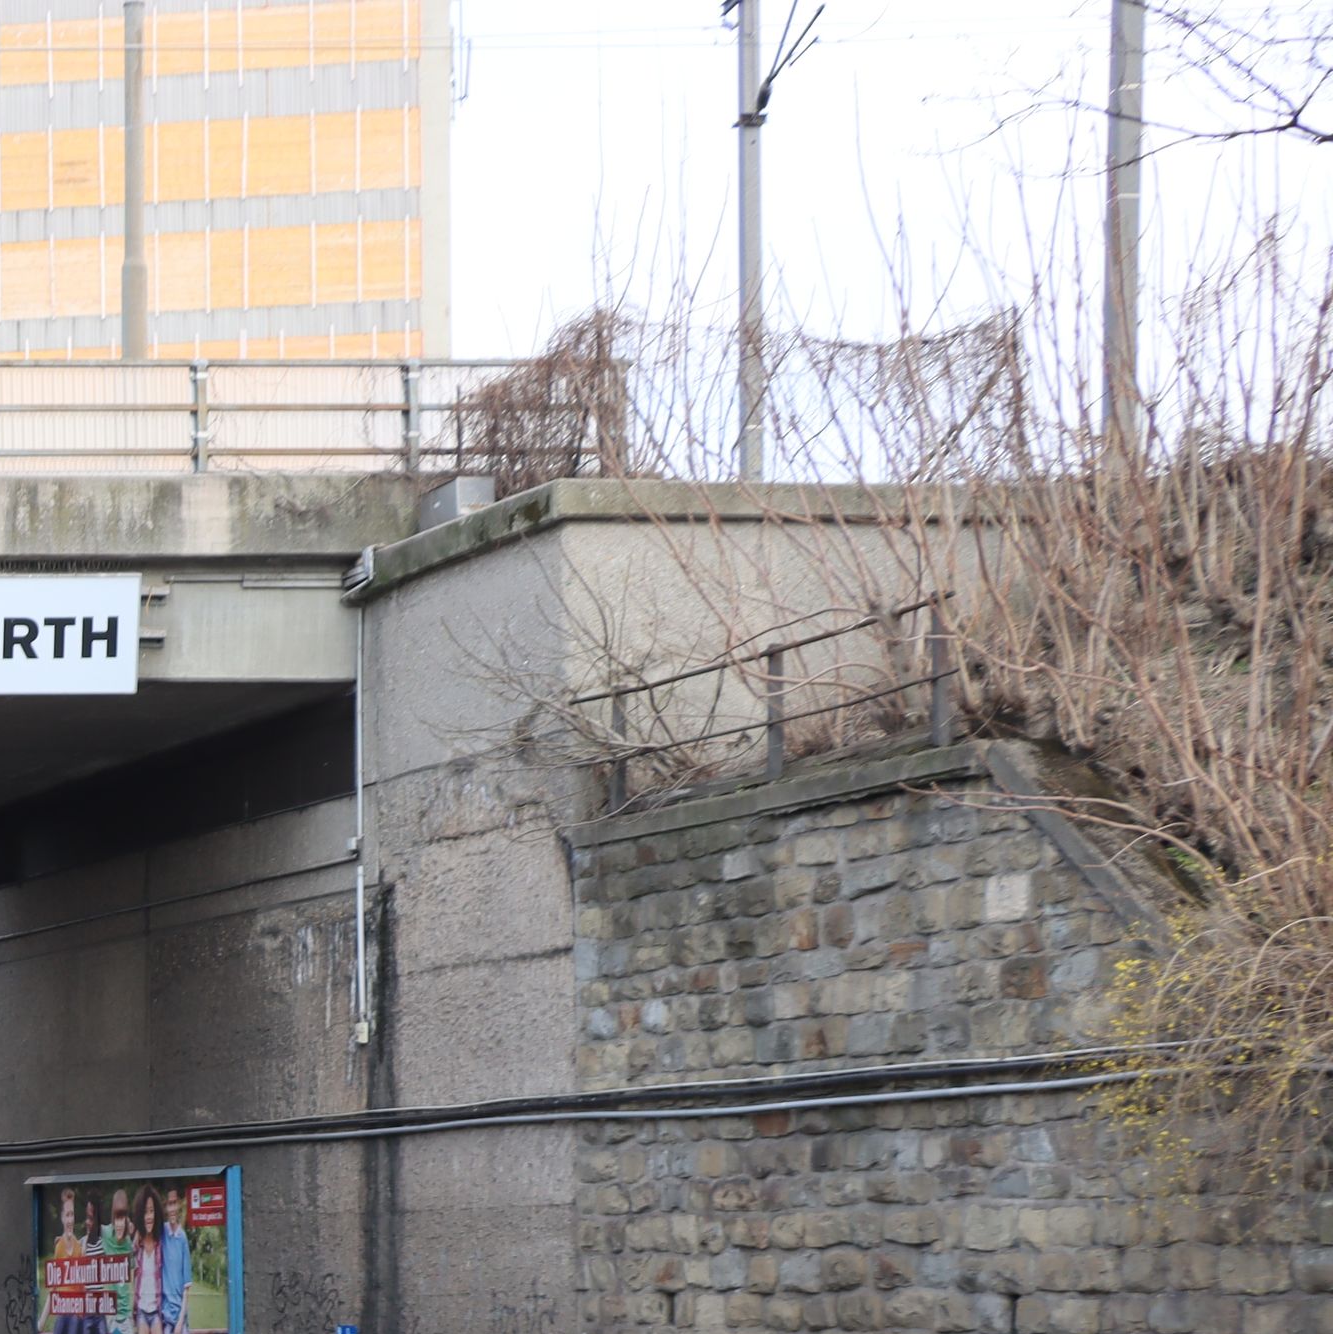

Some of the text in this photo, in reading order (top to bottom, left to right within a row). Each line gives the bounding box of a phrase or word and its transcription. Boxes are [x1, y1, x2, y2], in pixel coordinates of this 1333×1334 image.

[46, 1257, 129, 1287] Die Zukunft bringt
[52, 1291, 116, 1313] Chancen für alle.
